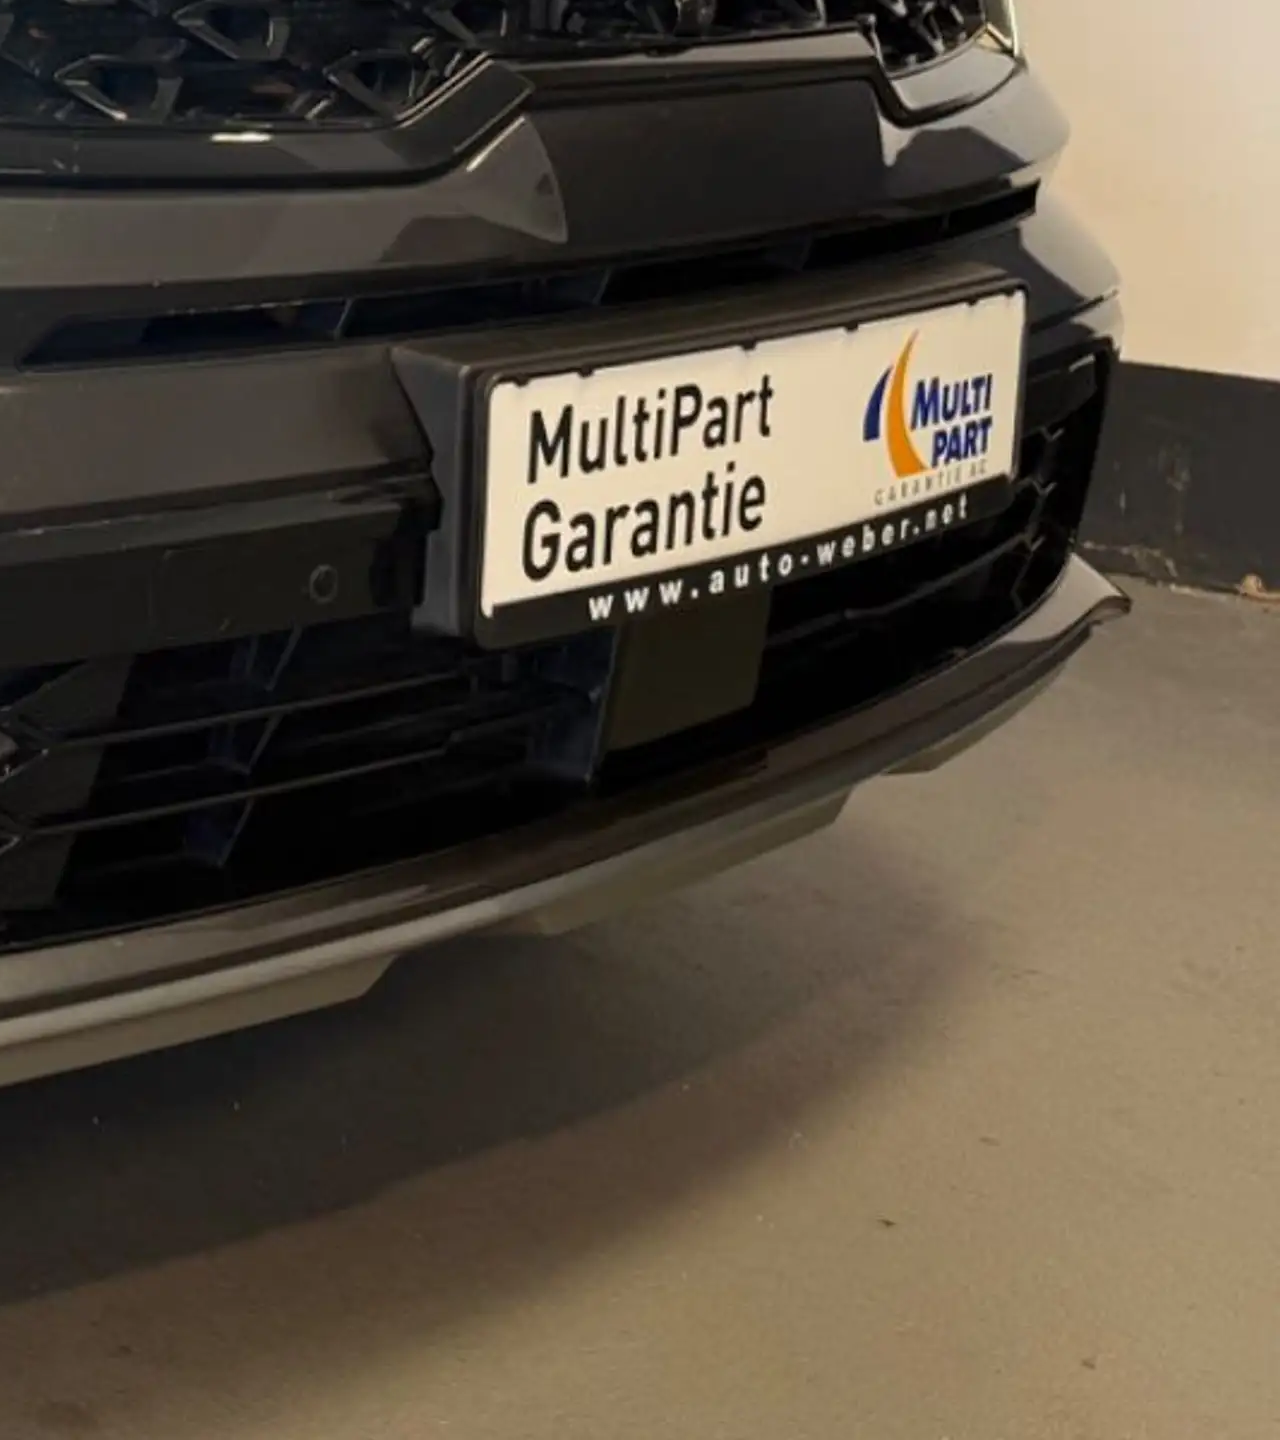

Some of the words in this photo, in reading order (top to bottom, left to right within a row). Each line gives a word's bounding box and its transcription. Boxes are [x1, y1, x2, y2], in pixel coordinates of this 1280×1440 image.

[526, 374, 774, 485] MultiPart
[910, 372, 993, 430] MULTI
[931, 416, 993, 469] PART
[521, 461, 767, 581] Garantie
[588, 494, 969, 622] www.auto-weber.net
